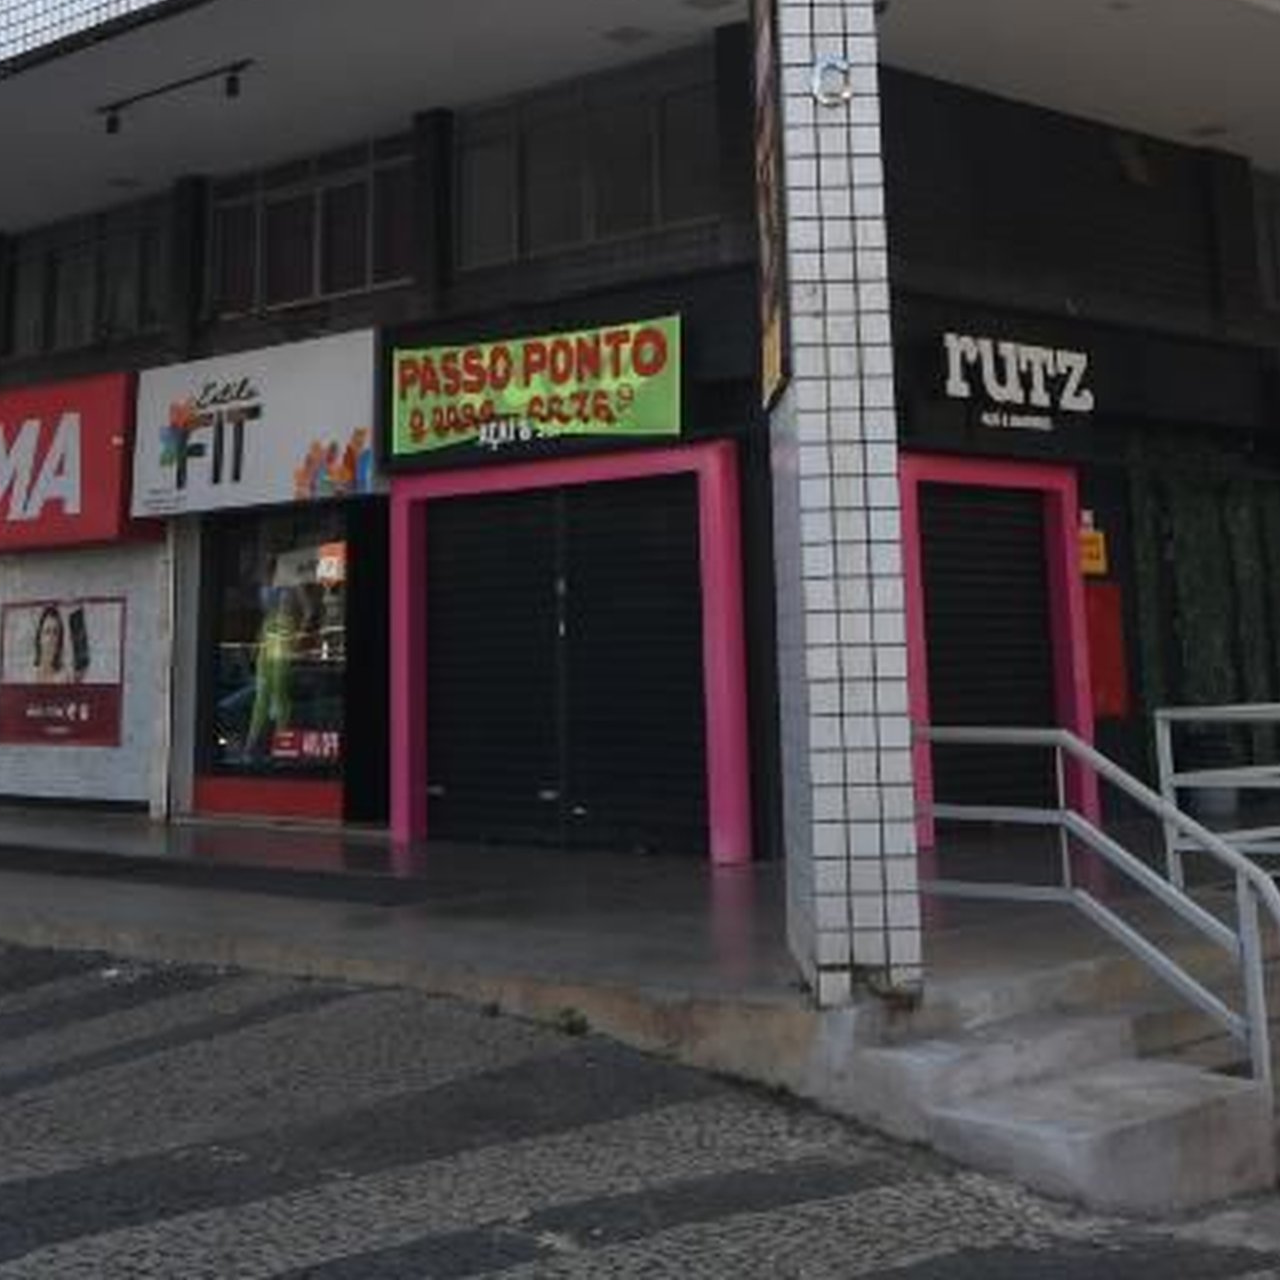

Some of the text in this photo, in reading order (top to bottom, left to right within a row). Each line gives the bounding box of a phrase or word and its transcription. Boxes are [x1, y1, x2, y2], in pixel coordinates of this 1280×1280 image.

[397, 325, 668, 401] PASSO PONTO
[164, 400, 263, 491] FIT
